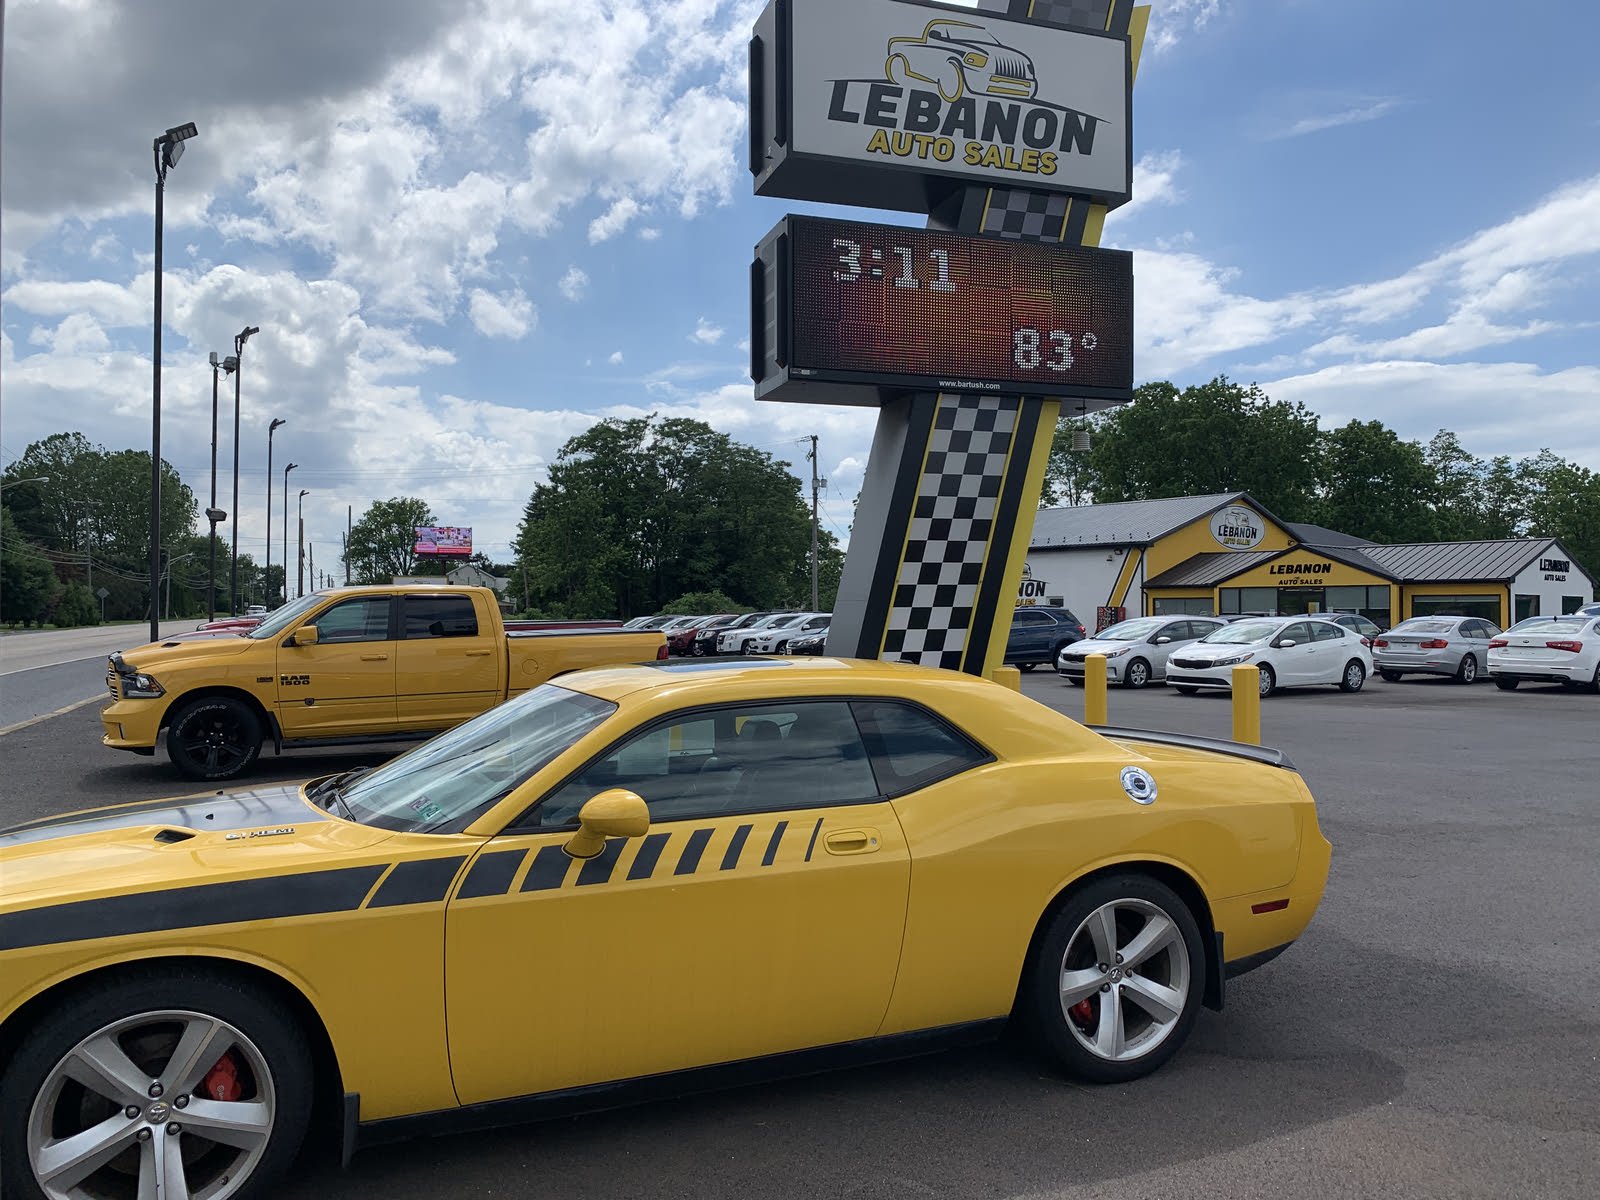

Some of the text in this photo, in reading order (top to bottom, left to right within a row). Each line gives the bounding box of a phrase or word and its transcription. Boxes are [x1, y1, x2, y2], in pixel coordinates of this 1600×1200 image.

[827, 80, 1097, 156] LEBANON
[867, 129, 1058, 175] AUTO SALES
[832, 238, 956, 293] 3:11
[1012, 327, 1098, 372] 83°
[938, 380, 1001, 391] www.bartush.com
[1218, 525, 1257, 539] LEBANON
[1269, 563, 1332, 574] LEBANON
[1544, 574, 1567, 582] AUTO SALES
